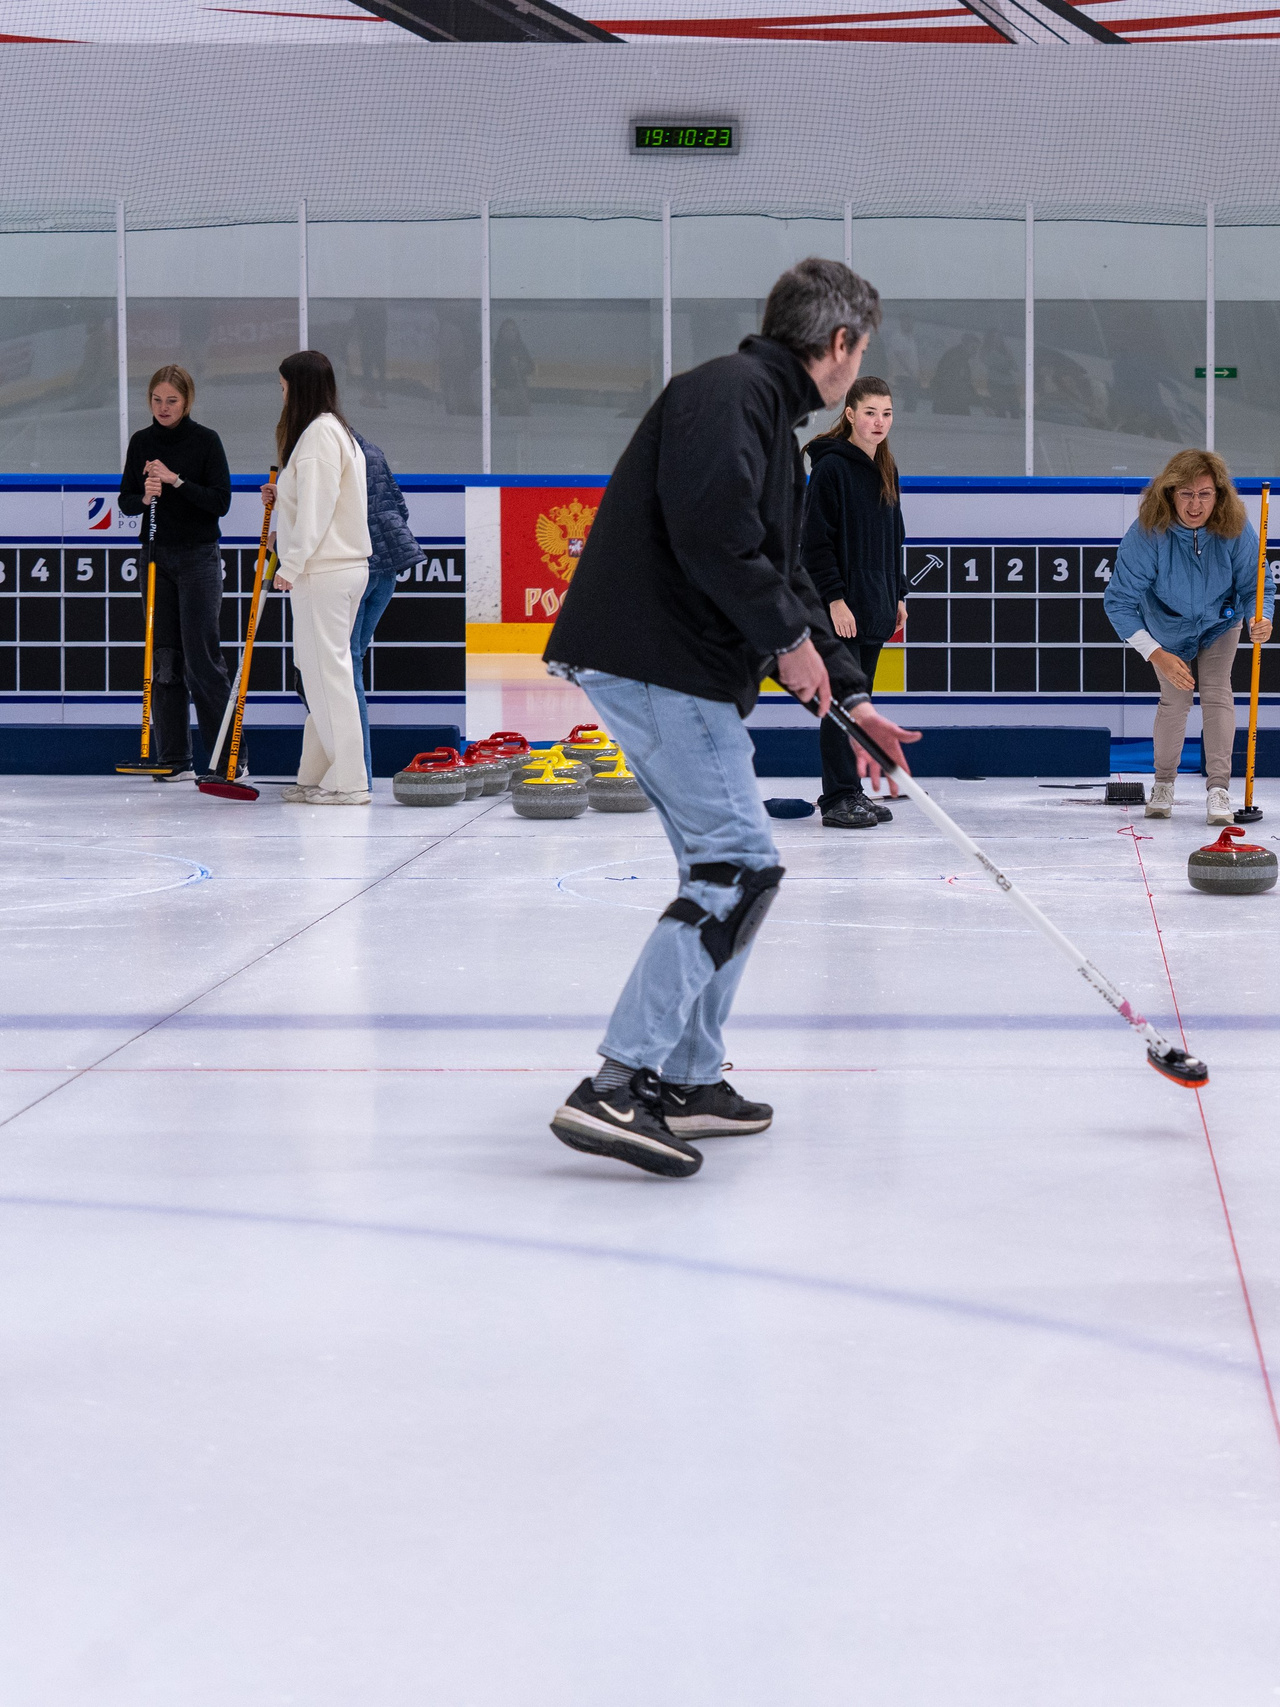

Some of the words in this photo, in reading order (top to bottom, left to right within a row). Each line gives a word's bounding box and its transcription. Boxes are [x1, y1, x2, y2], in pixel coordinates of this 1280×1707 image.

[645, 129, 730, 146] 19:10:23
[149, 496, 158, 541] alancePlus
[31, 557, 50, 582] 4
[76, 557, 94, 581] 5
[120, 557, 138, 582] 6
[963, 558, 979, 582] 1
[1007, 557, 1024, 582] 2
[1052, 557, 1070, 582] 3
[1094, 557, 1113, 582] 4
